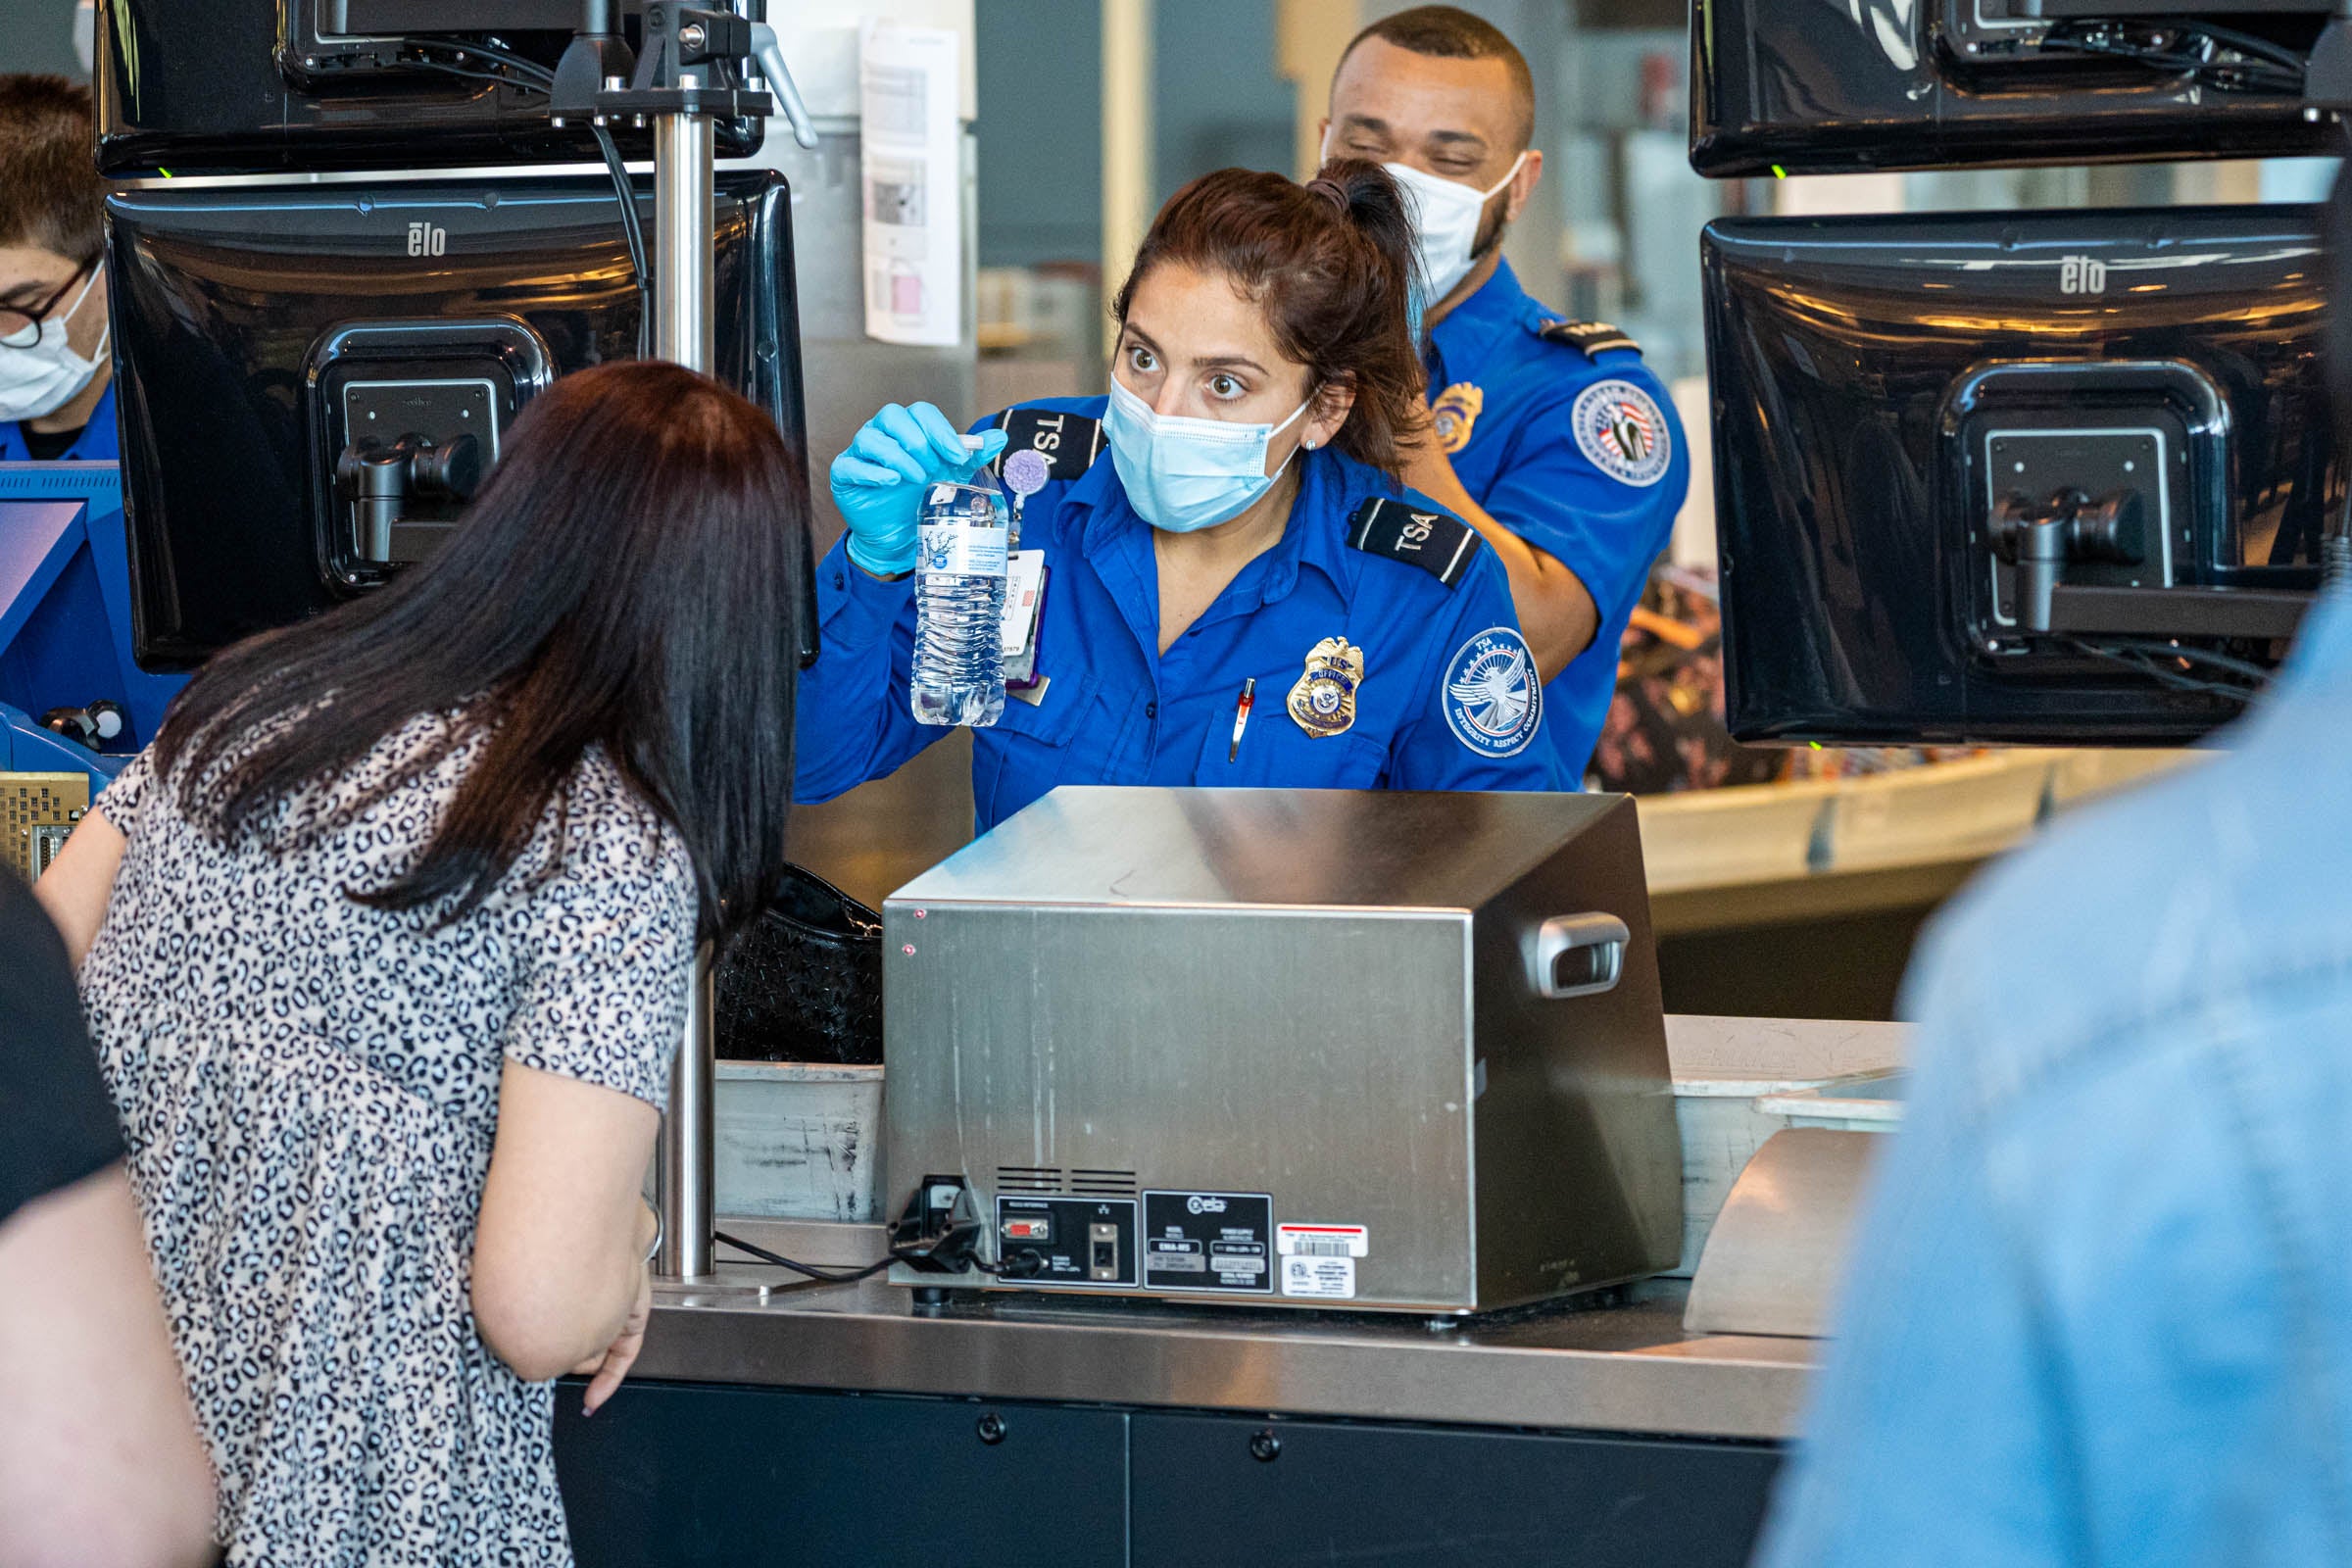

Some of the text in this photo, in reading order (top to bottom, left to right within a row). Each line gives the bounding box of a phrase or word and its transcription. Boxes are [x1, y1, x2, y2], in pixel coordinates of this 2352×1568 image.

[1394, 514, 1439, 551] TSA
[1475, 637, 1493, 650] TSA
[1454, 668, 1538, 748] INTEGRITY RESPECT COMMITMENT
